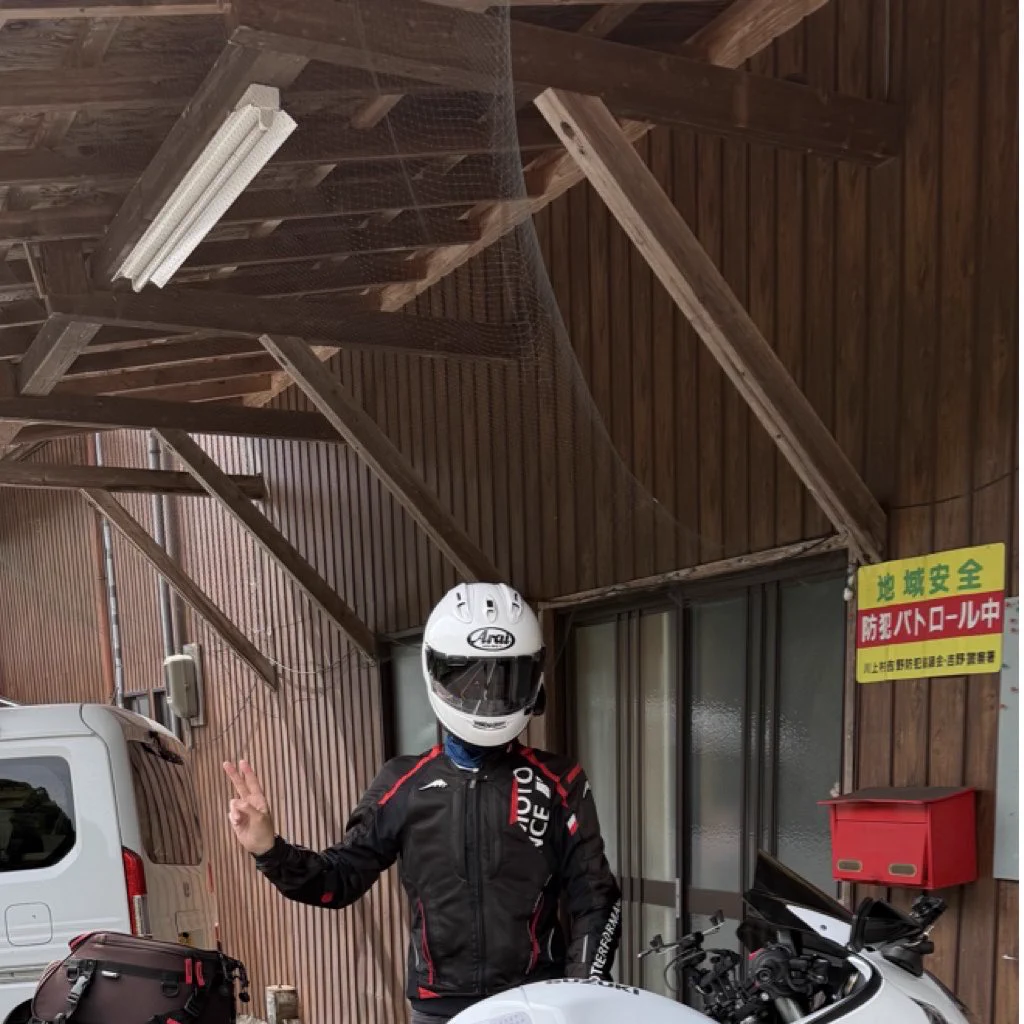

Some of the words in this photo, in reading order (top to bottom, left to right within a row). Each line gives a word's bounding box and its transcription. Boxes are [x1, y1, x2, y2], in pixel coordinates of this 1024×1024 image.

[877, 558, 983, 602] 地域安全
[470, 629, 511, 645] Arai
[861, 597, 1001, 643] 防犯パトロール中
